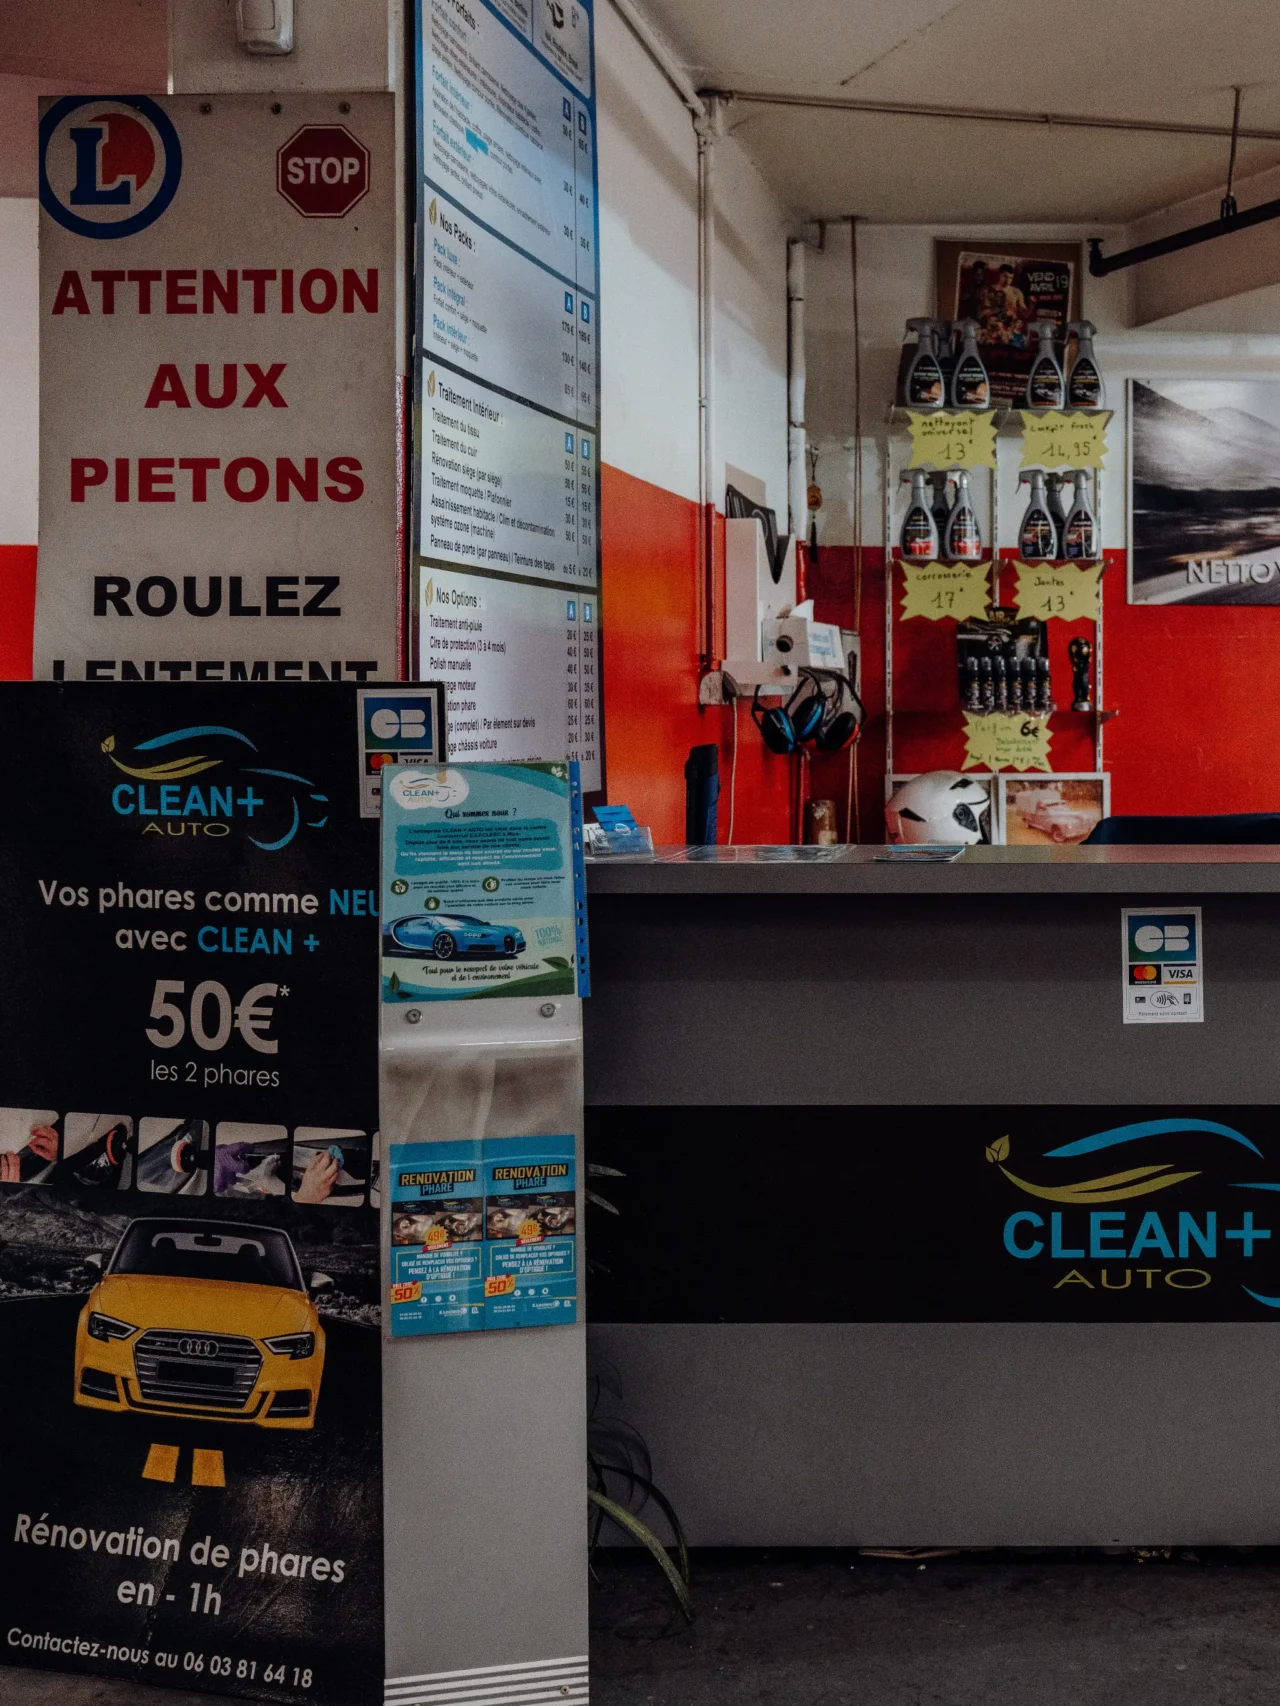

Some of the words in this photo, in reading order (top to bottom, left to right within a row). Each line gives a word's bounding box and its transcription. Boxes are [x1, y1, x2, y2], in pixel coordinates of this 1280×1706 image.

[287, 157, 360, 184] STOP
[440, 212, 452, 237] Nos
[454, 224, 472, 250] Packs
[51, 268, 379, 315] ATTENTION
[144, 363, 289, 409] AUX
[439, 382, 472, 411] Traitement
[473, 398, 499, 423] Intérieur
[432, 407, 459, 429] Traitement
[460, 420, 466, 433] du
[467, 423, 480, 439] tissu
[432, 430, 459, 452] Traitement
[460, 442, 467, 453] du
[468, 445, 477, 457] cuir
[432, 451, 461, 473] Rénovation
[70, 456, 365, 503] PIETONS
[432, 472, 459, 492] Traitement
[460, 482, 483, 501] moquette
[473, 505, 495, 522] habitacle
[431, 533, 453, 550] Panneau
[454, 541, 461, 552] de
[462, 543, 475, 556] porte
[454, 521, 469, 533] ozone
[471, 521, 495, 541] (machine)
[93, 575, 341, 617] ROULEZ
[436, 587, 449, 605] Nos
[452, 590, 477, 608] Options
[430, 615, 457, 631] Traitement
[459, 619, 482, 633] anti-pluie
[430, 636, 441, 649] Cire
[442, 639, 448, 649] de
[450, 640, 477, 653] protection
[430, 657, 446, 670] Polish
[448, 658, 471, 671] manuelle
[371, 708, 426, 739] CB
[522, 718, 535, 728] devis
[480, 739, 497, 750] voiture
[111, 783, 264, 817] CLEAN+
[402, 789, 440, 797] CLEAN+
[445, 808, 460, 818] Qui
[462, 810, 489, 818] sommes
[492, 809, 509, 817] nous
[141, 822, 230, 837] AUTO
[38, 880, 89, 907] Vos
[99, 882, 196, 914] phares
[205, 890, 319, 915] comme
[329, 889, 380, 917] NEU
[115, 927, 187, 952] avec
[197, 926, 292, 955] CLEAN
[303, 934, 320, 952] +
[1135, 925, 1190, 952] CB
[1168, 969, 1193, 979] VISA
[150, 1060, 178, 1081] les
[184, 1062, 198, 1083] 2
[204, 1063, 280, 1088] phares
[401, 1170, 474, 1186] RENOVATION
[495, 1164, 566, 1180] RENOVATION
[516, 1177, 545, 1189] PHARE
[422, 1183, 452, 1195] PHARE
[1003, 1210, 1271, 1259] CLEAN+
[1053, 1268, 1211, 1289] AUTO
[14, 1513, 181, 1562] Rénovation
[190, 1536, 230, 1568] de
[238, 1543, 346, 1583] phares
[116, 1580, 155, 1606] en
[190, 1582, 222, 1616] 1h
[7, 1627, 149, 1664] Contactez-nous
[155, 1651, 179, 1668] au
[183, 1652, 204, 1672] 06
[210, 1656, 232, 1676] 03
[236, 1660, 258, 1680] 81
[263, 1664, 285, 1683] 64
[292, 1667, 313, 1688] 18
